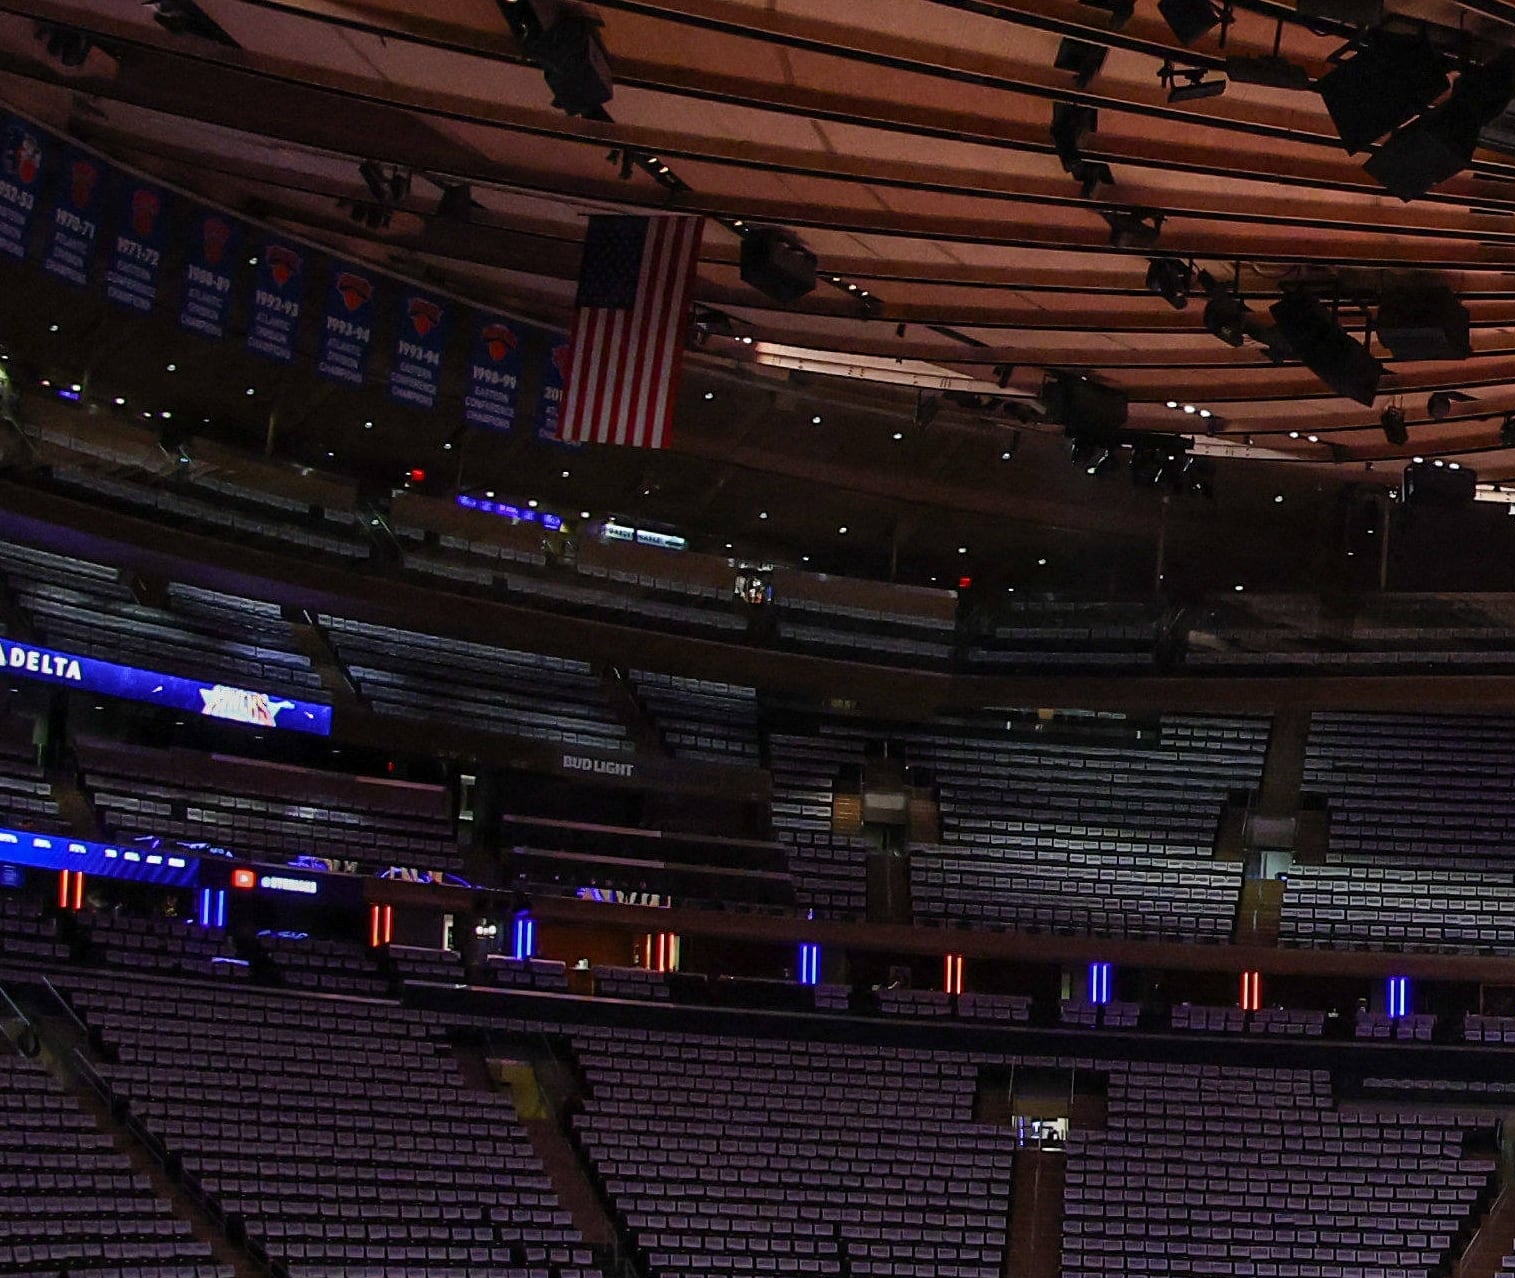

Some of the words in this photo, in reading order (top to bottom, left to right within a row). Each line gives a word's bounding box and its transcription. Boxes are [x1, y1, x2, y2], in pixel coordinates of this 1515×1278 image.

[255, 289, 299, 317] 1992-93
[326, 315, 370, 343] 1993-94
[473, 365, 517, 389] 1998-99
[9, 647, 82, 681] DELTA
[563, 755, 592, 780] BUD
[594, 760, 634, 787] LIGHT
